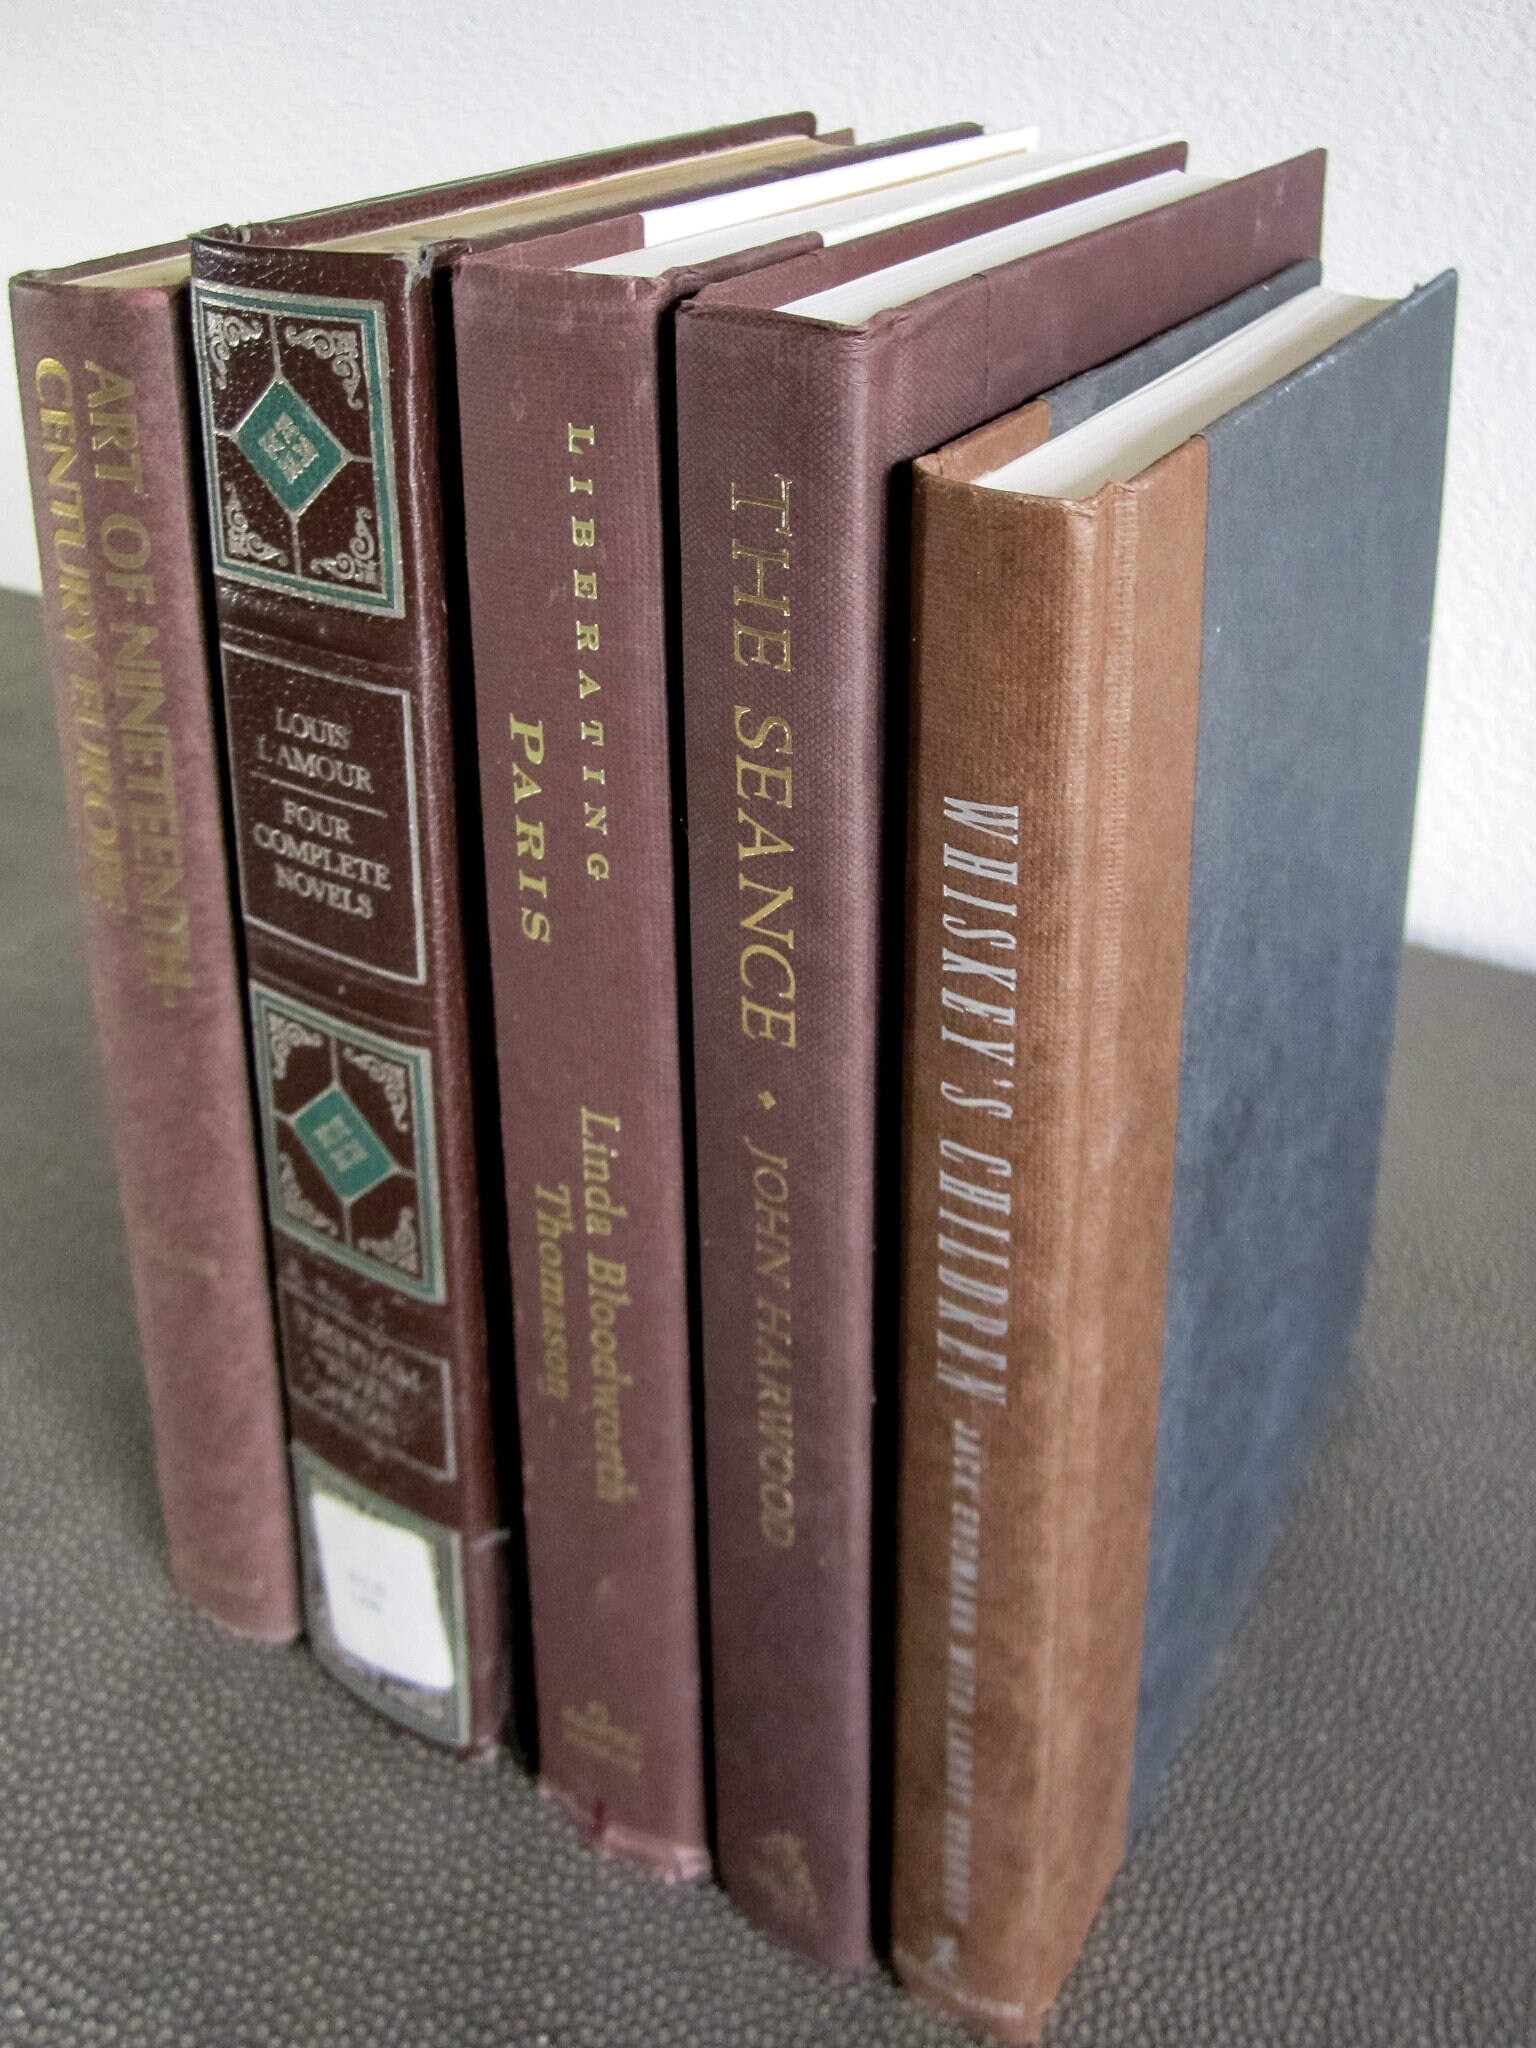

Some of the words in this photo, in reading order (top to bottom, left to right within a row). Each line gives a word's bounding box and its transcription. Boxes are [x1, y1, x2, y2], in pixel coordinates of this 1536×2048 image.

[85, 359, 149, 497] ART
[35, 357, 97, 648] CENTURY
[67, 672, 128, 914] EUROPE
[101, 513, 156, 605] OF
[567, 422, 609, 882] LIBERATING
[727, 472, 792, 672] THE
[275, 706, 352, 750] LOUIS
[282, 798, 354, 845] FOUR
[509, 712, 551, 944] PARIS
[253, 822, 392, 892] COMPLETE
[274, 863, 375, 919] NOVELS
[733, 705, 797, 1050] SEANCE
[940, 796, 1019, 1120] WHISKEY'S
[580, 1105, 629, 1236] Linda
[743, 1135, 791, 1291] JOHN
[936, 1138, 1012, 1406] CHILDREN
[534, 1183, 575, 1400] Thomason
[587, 1251, 638, 1502] Bloodworth
[755, 1295, 796, 1549] HARWOOD
